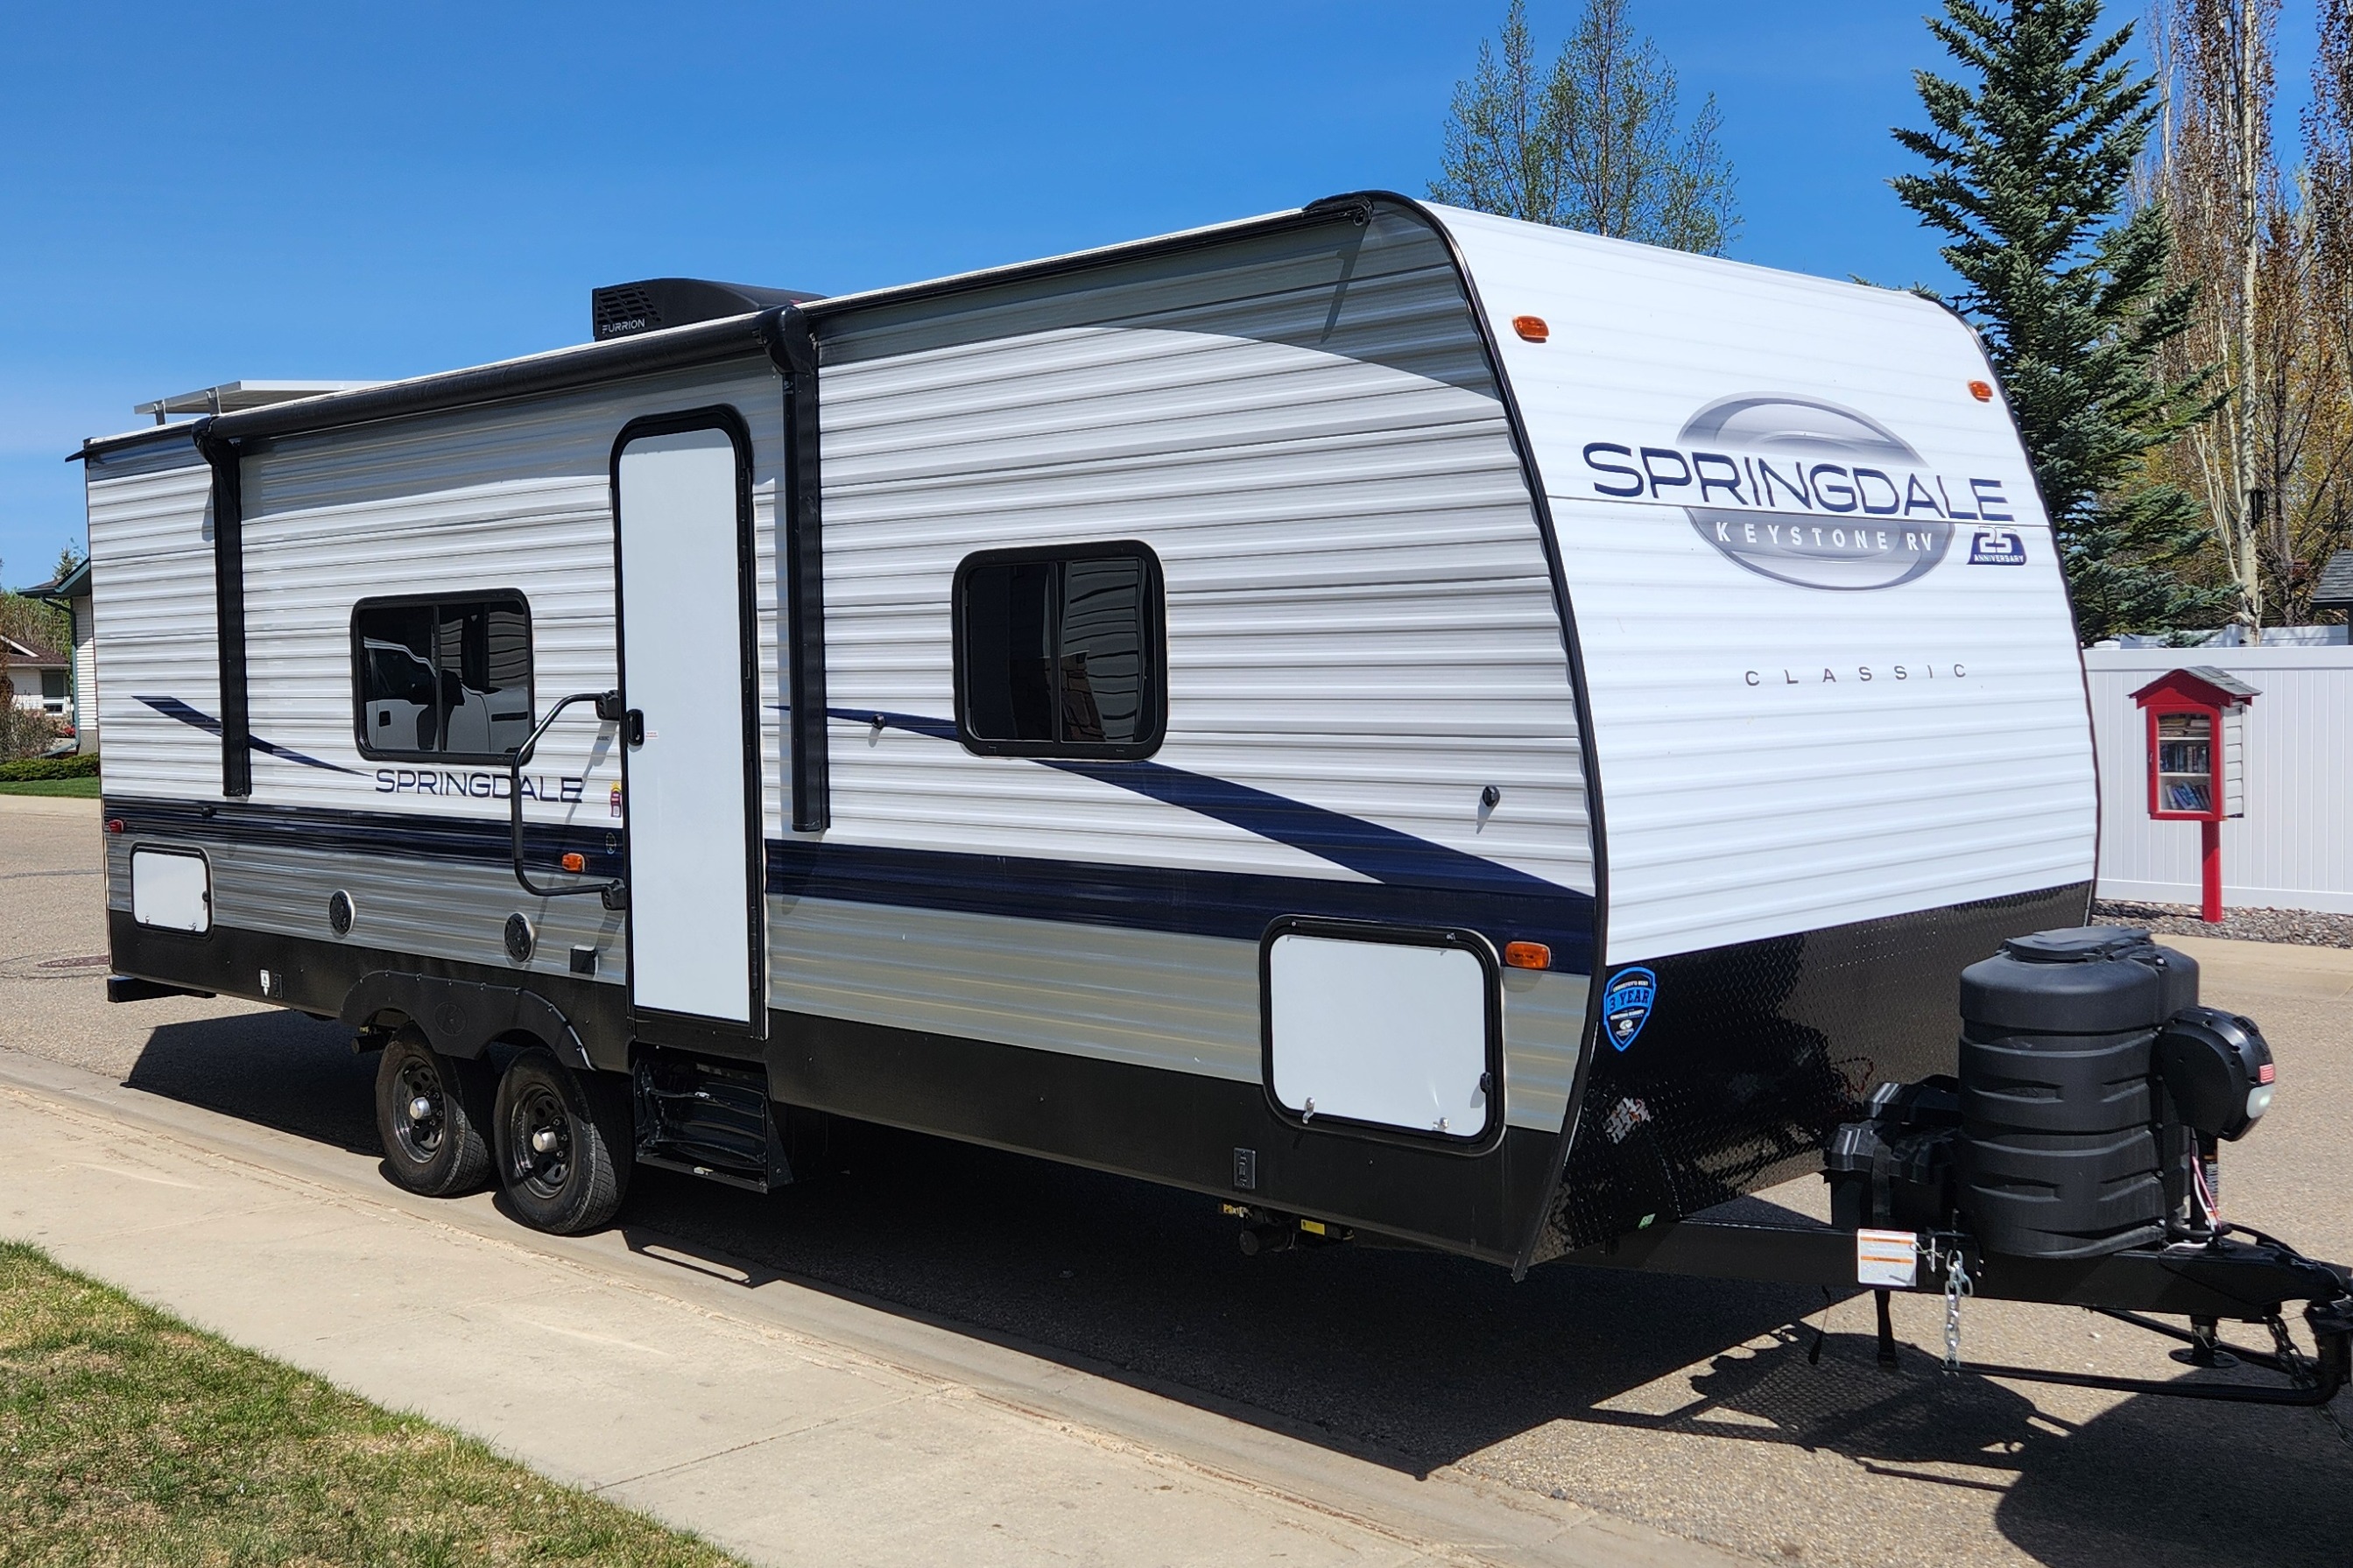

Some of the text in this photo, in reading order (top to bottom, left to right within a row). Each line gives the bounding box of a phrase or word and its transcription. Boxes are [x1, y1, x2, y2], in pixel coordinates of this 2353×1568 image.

[602, 318, 645, 334] FURRION
[1582, 441, 2014, 522] SPRINGDALE
[1715, 521, 1934, 552] KEYSTONE RV
[1978, 526, 2014, 553] 25
[1973, 553, 2025, 563] ANNIVERSARY
[1745, 663, 1967, 686] CLASSIC
[375, 768, 583, 804] SPRINGDALE
[1610, 989, 1651, 1011] 3 YEAR
